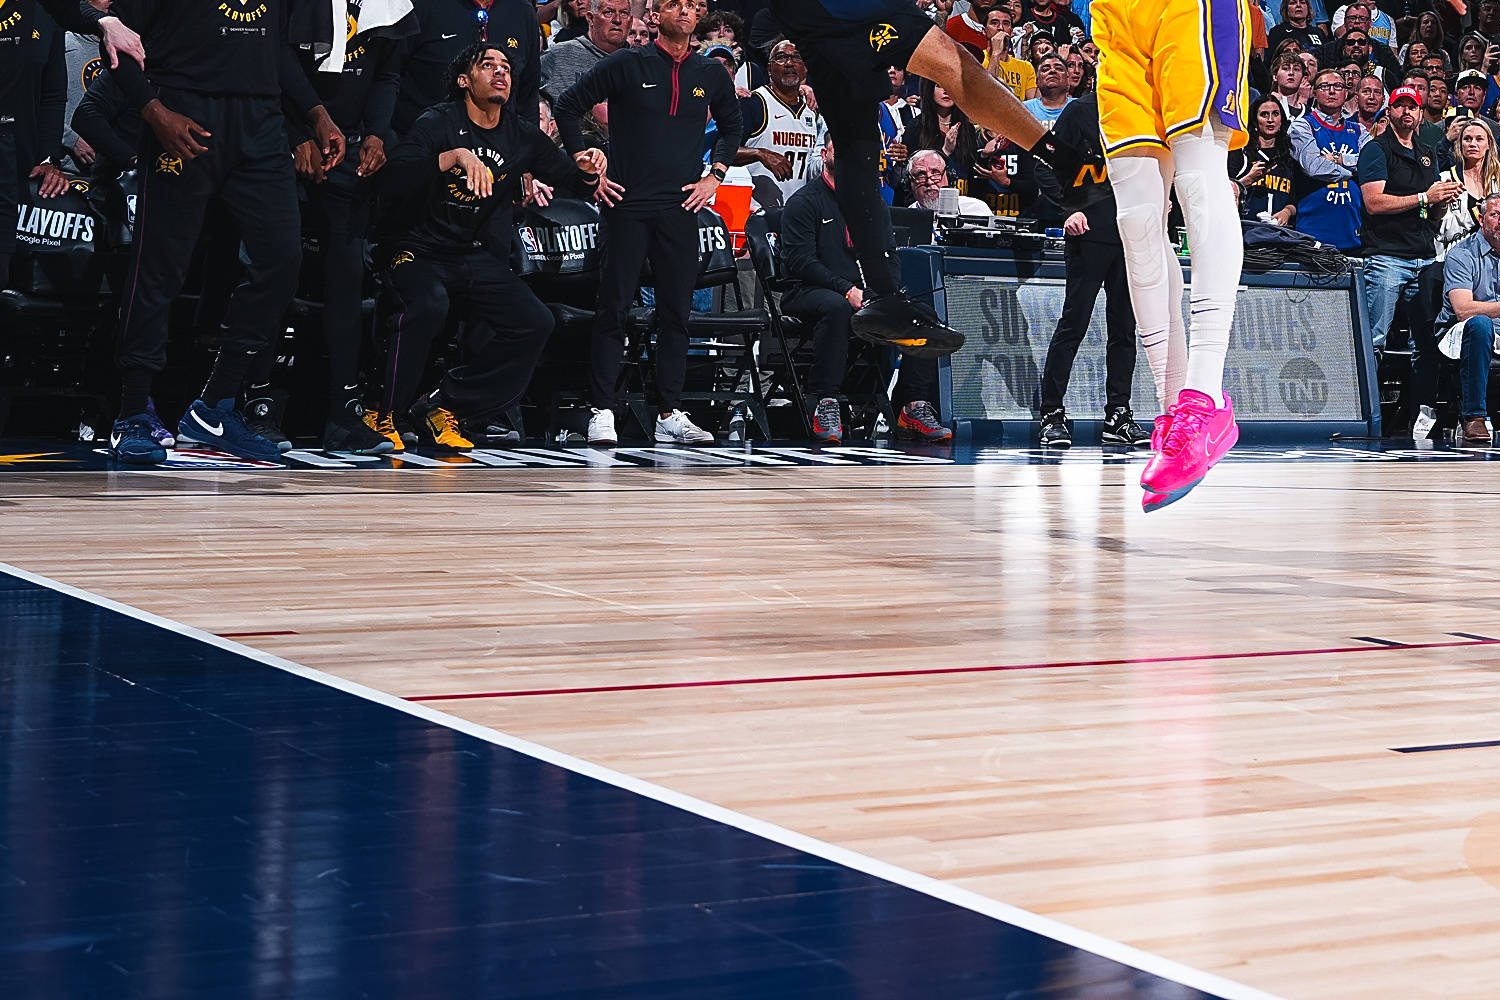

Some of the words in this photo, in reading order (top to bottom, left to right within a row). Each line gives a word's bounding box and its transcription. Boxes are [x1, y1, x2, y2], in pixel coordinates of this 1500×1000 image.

[218, 2, 269, 23] PLAYOFFS
[1308, 34, 1323, 46] 15
[773, 131, 817, 147] NUGGETS
[1326, 190, 1353, 204] CITY
[16, 204, 95, 243] LAYOFFS
[42, 237, 62, 247] Pixel
[536, 223, 600, 254] PLAYOFF
